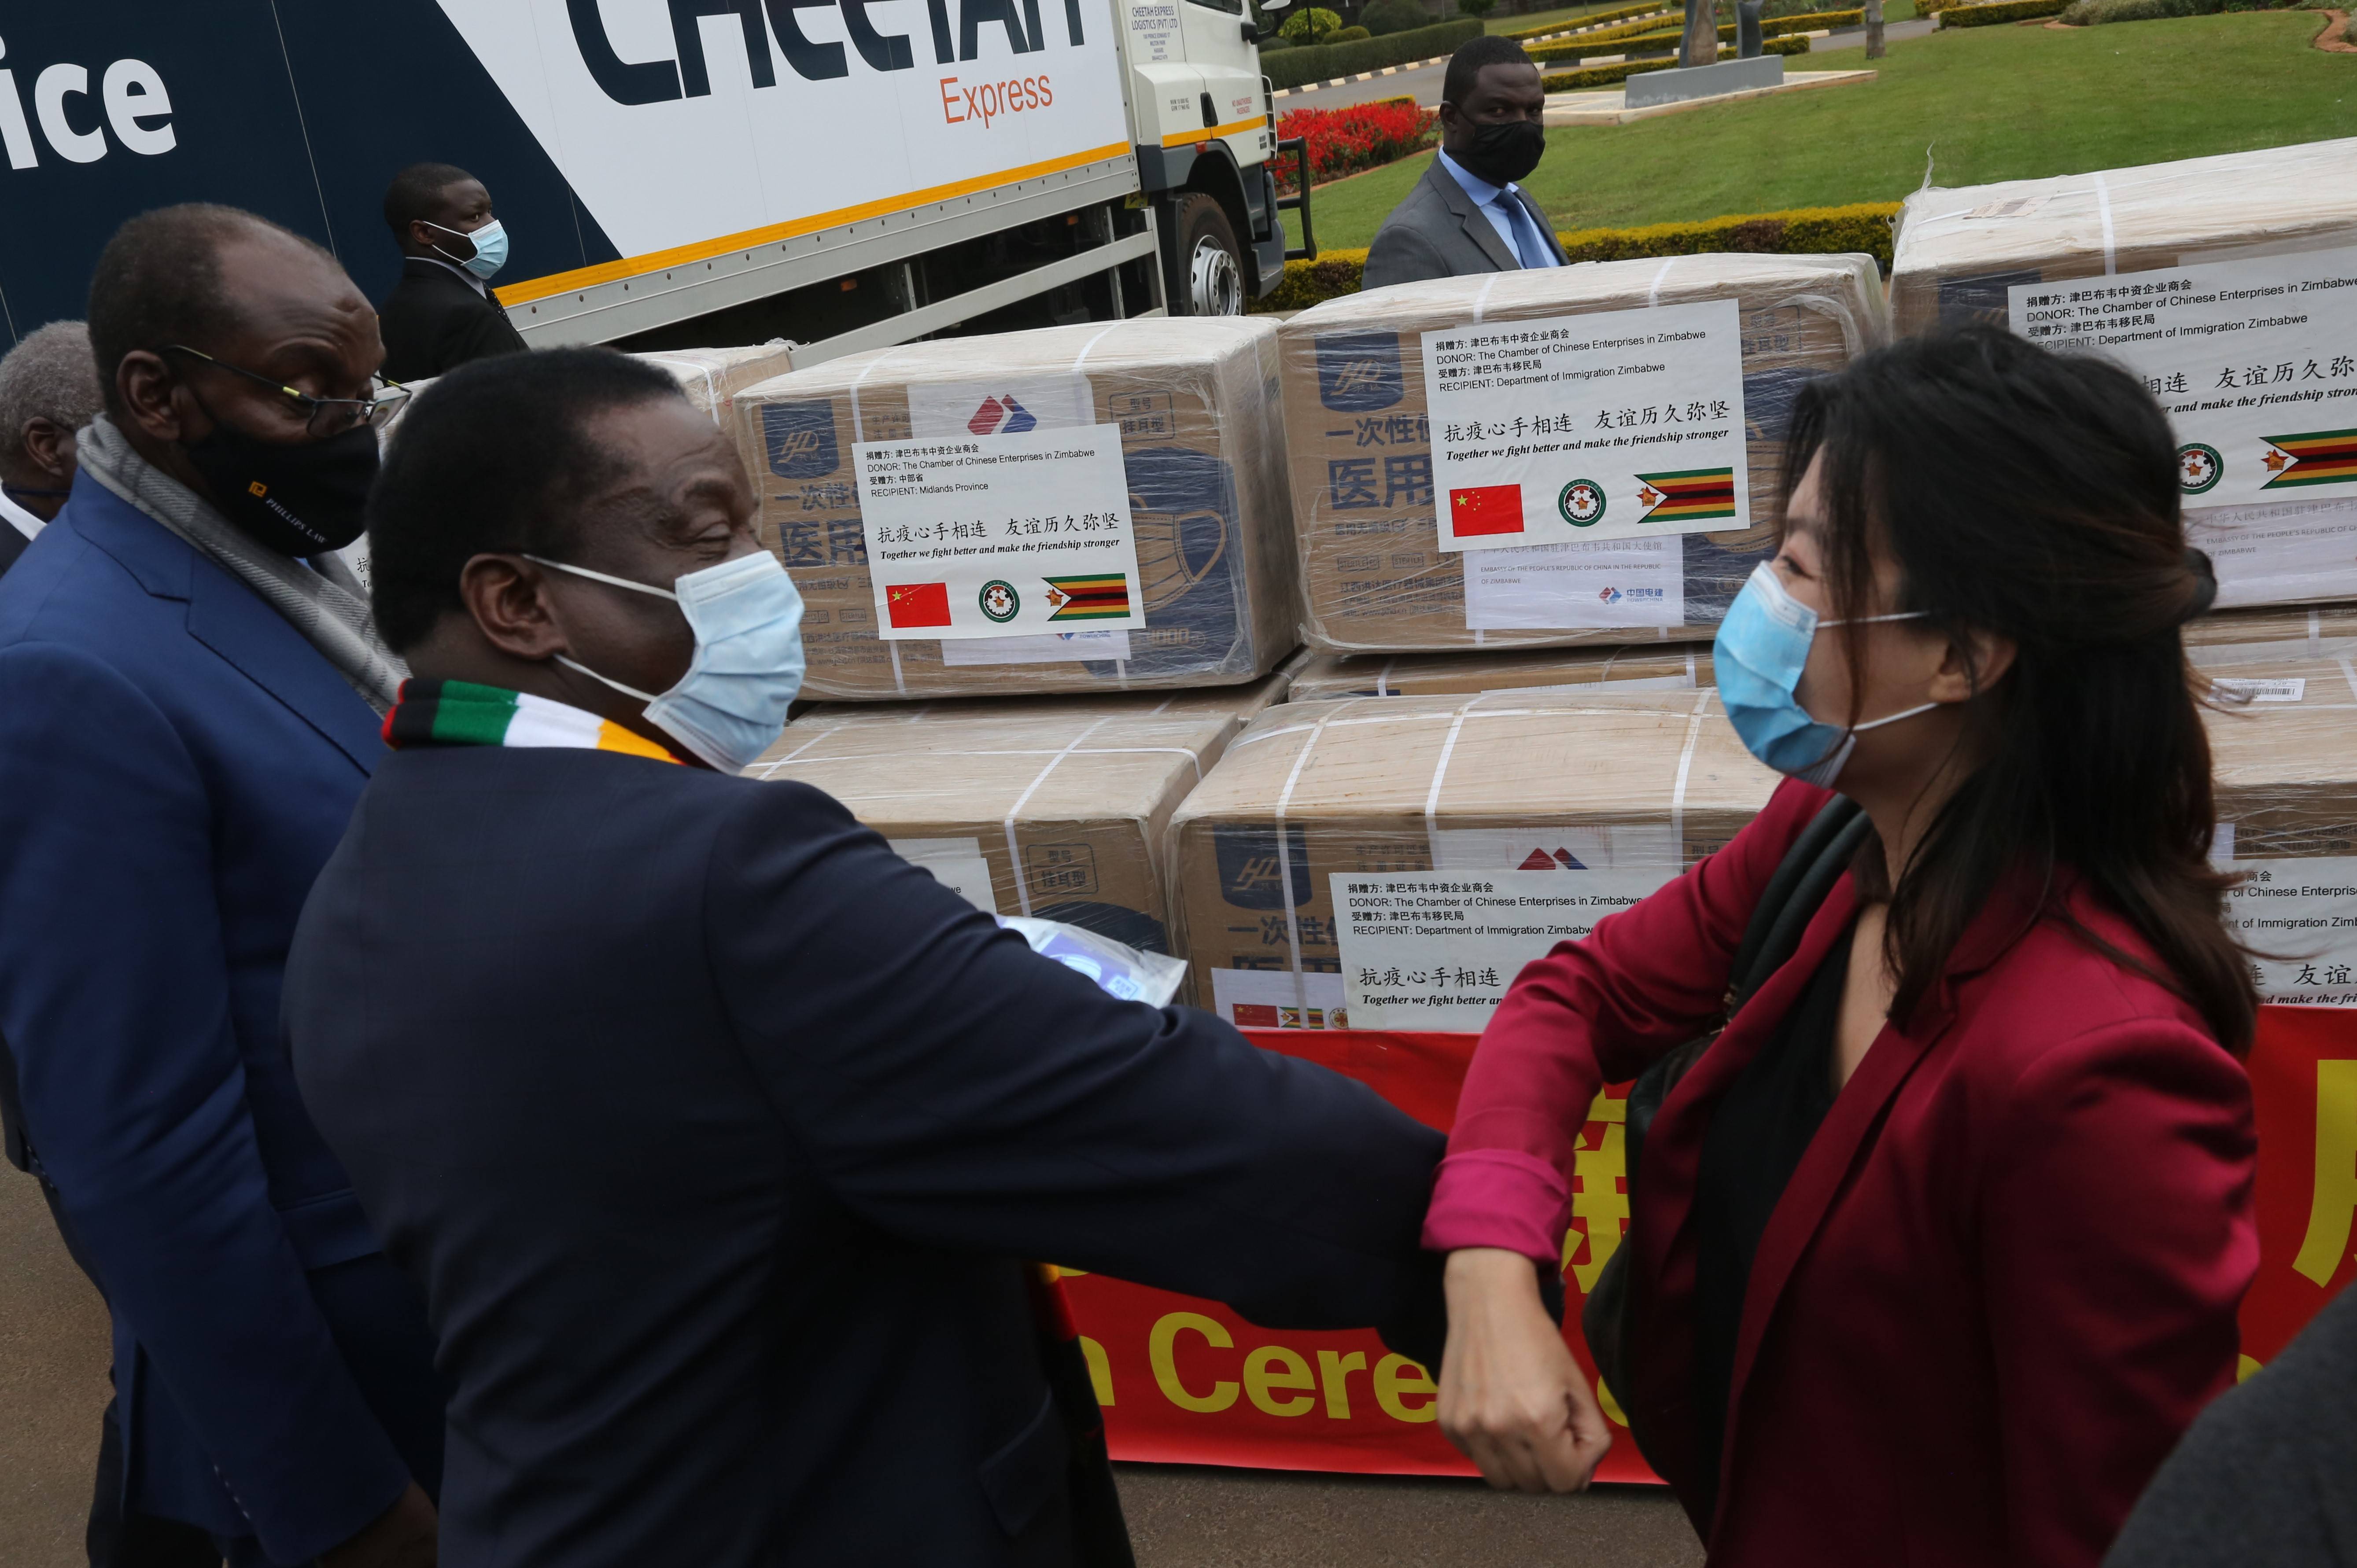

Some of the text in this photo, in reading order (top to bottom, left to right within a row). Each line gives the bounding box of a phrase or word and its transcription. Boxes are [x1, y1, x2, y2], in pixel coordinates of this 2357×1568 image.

[1132, 5, 1174, 17] CHEETAH EXPRESS
[1131, 18, 1178, 30] LOGISTICS (PVT) LTD
[939, 74, 1054, 129] Express
[2026, 279, 2192, 308] 捐赠方: 津巴布韦中资企业商会
[2027, 308, 2075, 322] DONOR:
[2077, 306, 2099, 317] The
[2102, 301, 2153, 314] Chamber
[2156, 297, 2167, 308] of
[2169, 294, 2216, 306] Chinese
[2220, 286, 2285, 301] Enterprises
[2287, 283, 2298, 293] in
[2028, 313, 2155, 338] 受赠方: 津巴布韦移民局
[2099, 315, 2308, 345] Department of Immigration Zimbabwe
[1435, 328, 1570, 352] 捐赠方: 津巴布韦中资企业商会
[1436, 331, 1706, 365] DONOR: The Chamber of Chinese Enterprises in Zimbabwe
[1438, 359, 1542, 379] 受赠方: 津巴布韦移民局
[1439, 363, 1665, 392] RECIPIENT: Department of Immigration Zimbabwe
[2174, 401, 2198, 413] and
[2200, 398, 2234, 410] make
[2236, 396, 2257, 407] the
[2257, 389, 2324, 408] friendship
[1444, 400, 1730, 443] 抗疫心手相连 友谊历久弥坚
[866, 443, 979, 461] 捐赠方: 津巴布韦中资企业商会
[1446, 449, 1489, 462] Together
[1505, 445, 1531, 458] fight
[1532, 443, 1560, 453] better
[1562, 439, 1582, 451] and
[1584, 438, 1611, 449] make
[1613, 436, 1630, 446] the
[1630, 431, 1683, 447] friendship
[1686, 430, 1729, 441] stronger
[867, 449, 1095, 473] DONOR: The Chamber of Chinese Enterprises in Zimbabwe
[869, 473, 923, 486] 受赠方: 中部省
[871, 482, 989, 497] RECIPIENT: Midlands Province
[266, 498, 328, 543] PHILLIPS LAW
[877, 512, 1120, 544] 抗疫心手相连 友谊历久弥坚
[2206, 535, 2239, 545] EMBASSY
[2267, 529, 2300, 538] PEOPLE'S
[2301, 526, 2336, 535] REPUBLIC
[880, 549, 917, 561] Together
[930, 547, 952, 559] fight
[953, 547, 977, 556] better
[979, 544, 996, 554] and
[997, 543, 1020, 553] make
[1022, 542, 1036, 552] the
[1036, 539, 1081, 553] friendship
[1083, 539, 1120, 549] stronger
[2218, 547, 2257, 556] ZIMBABWE
[1627, 588, 1664, 597] 中国电建
[1347, 882, 1494, 894] 捐赠方: 津巴布韦中资企业商会
[2248, 887, 2298, 897] Chinese
[2301, 885, 2357, 898] Enterpris
[1349, 898, 1392, 907] DONOR:
[1394, 898, 1414, 907] The
[1416, 897, 1461, 907] Chamber
[1463, 897, 1473, 906] of
[1475, 897, 1516, 907] Chinese
[1519, 896, 1576, 908] Enterprises
[1578, 896, 1588, 905] in
[1351, 910, 1464, 922] 受赠方: 津巴布韦移民局
[2242, 918, 2254, 928] of
[2257, 917, 2328, 930] Immigration
[1353, 925, 1593, 937] RECIPIENT: Department of Immigration Zimbabw
[1359, 966, 1501, 988] 抗疫心手相连
[1362, 994, 1409, 1007] Together
[1426, 994, 1454, 1007] fight
[1456, 995, 1487, 1005] better
[2277, 994, 2314, 1004] make
[2316, 994, 2338, 1004] the
[1148, 1311, 1438, 1423] Cere
